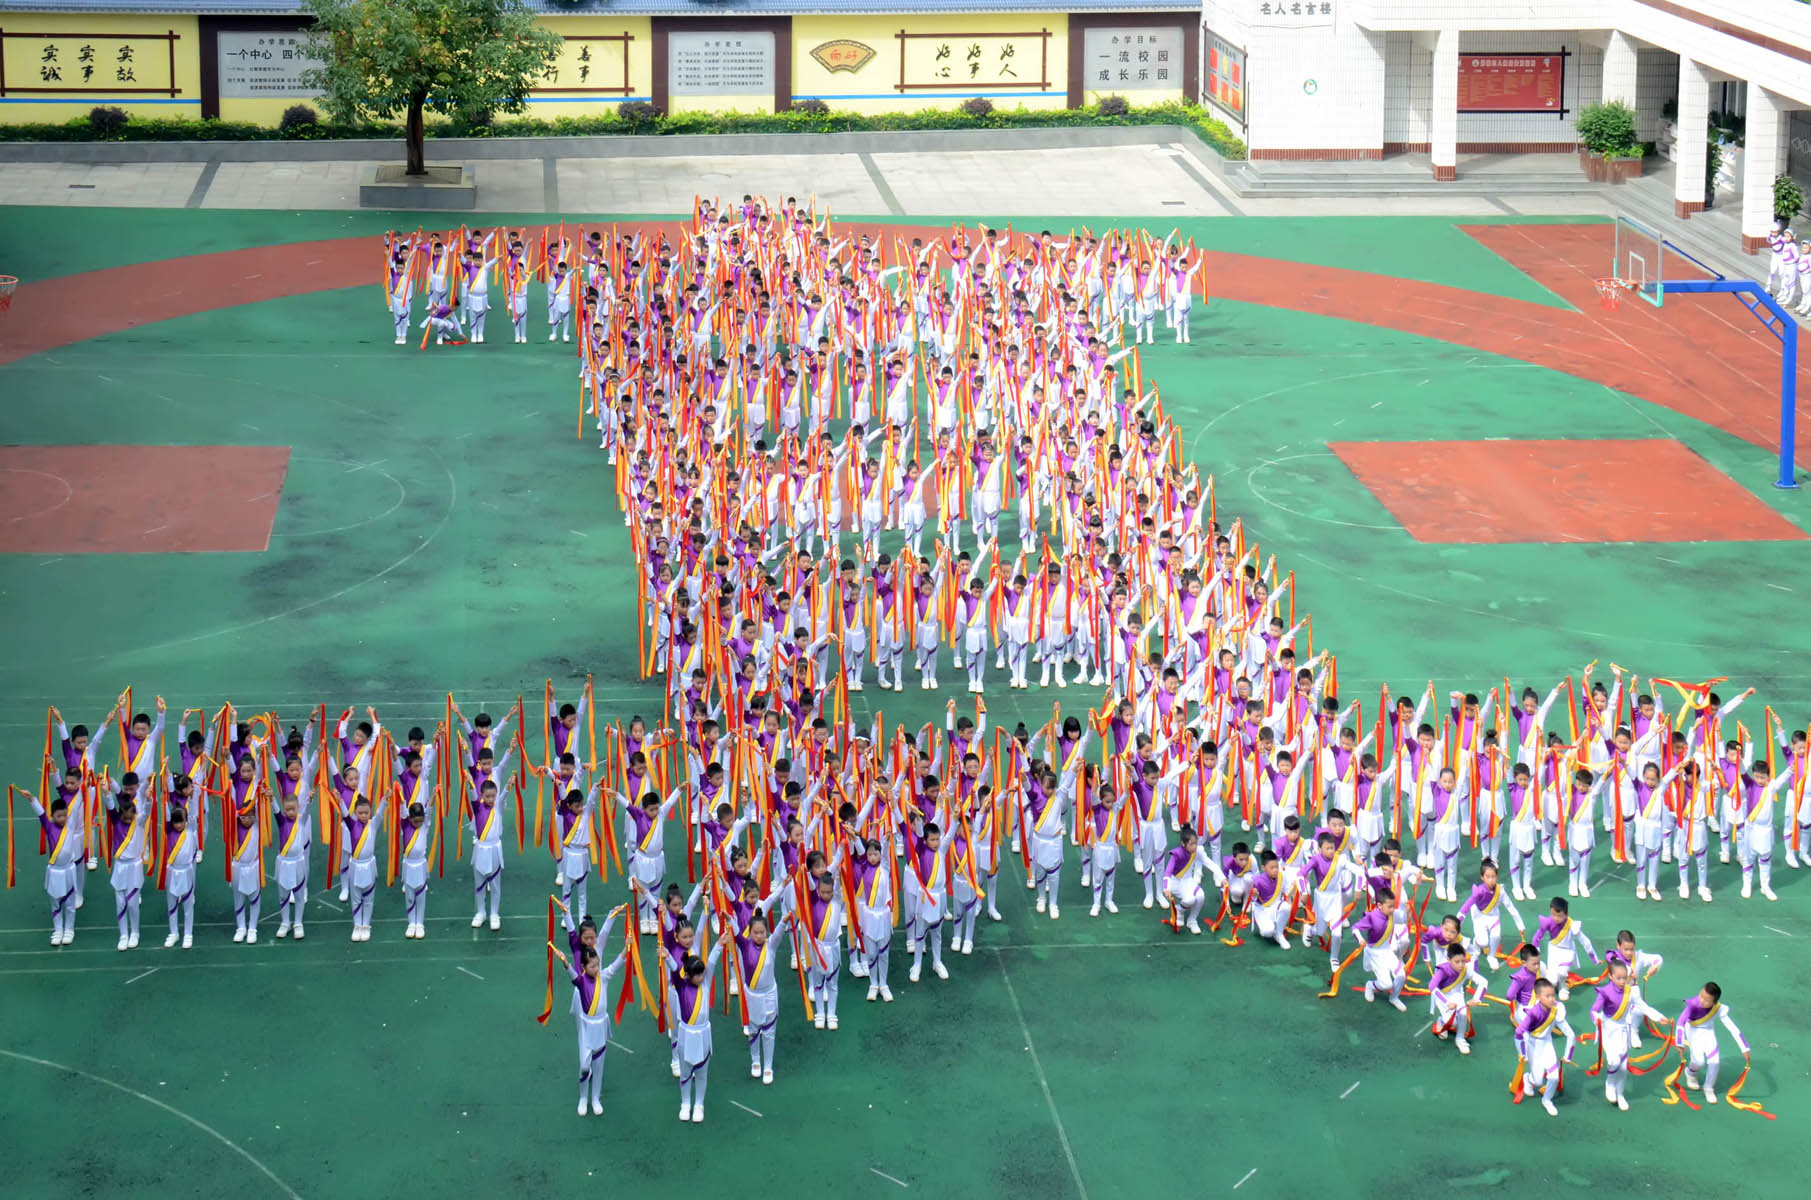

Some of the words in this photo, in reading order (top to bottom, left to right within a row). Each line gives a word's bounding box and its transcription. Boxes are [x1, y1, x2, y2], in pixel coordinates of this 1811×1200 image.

[226, 49, 273, 60] 一个中心
[999, 43, 1017, 77] 好人
[1099, 50, 1168, 62] 一流校园
[1099, 69, 1168, 81] 成长乐园
